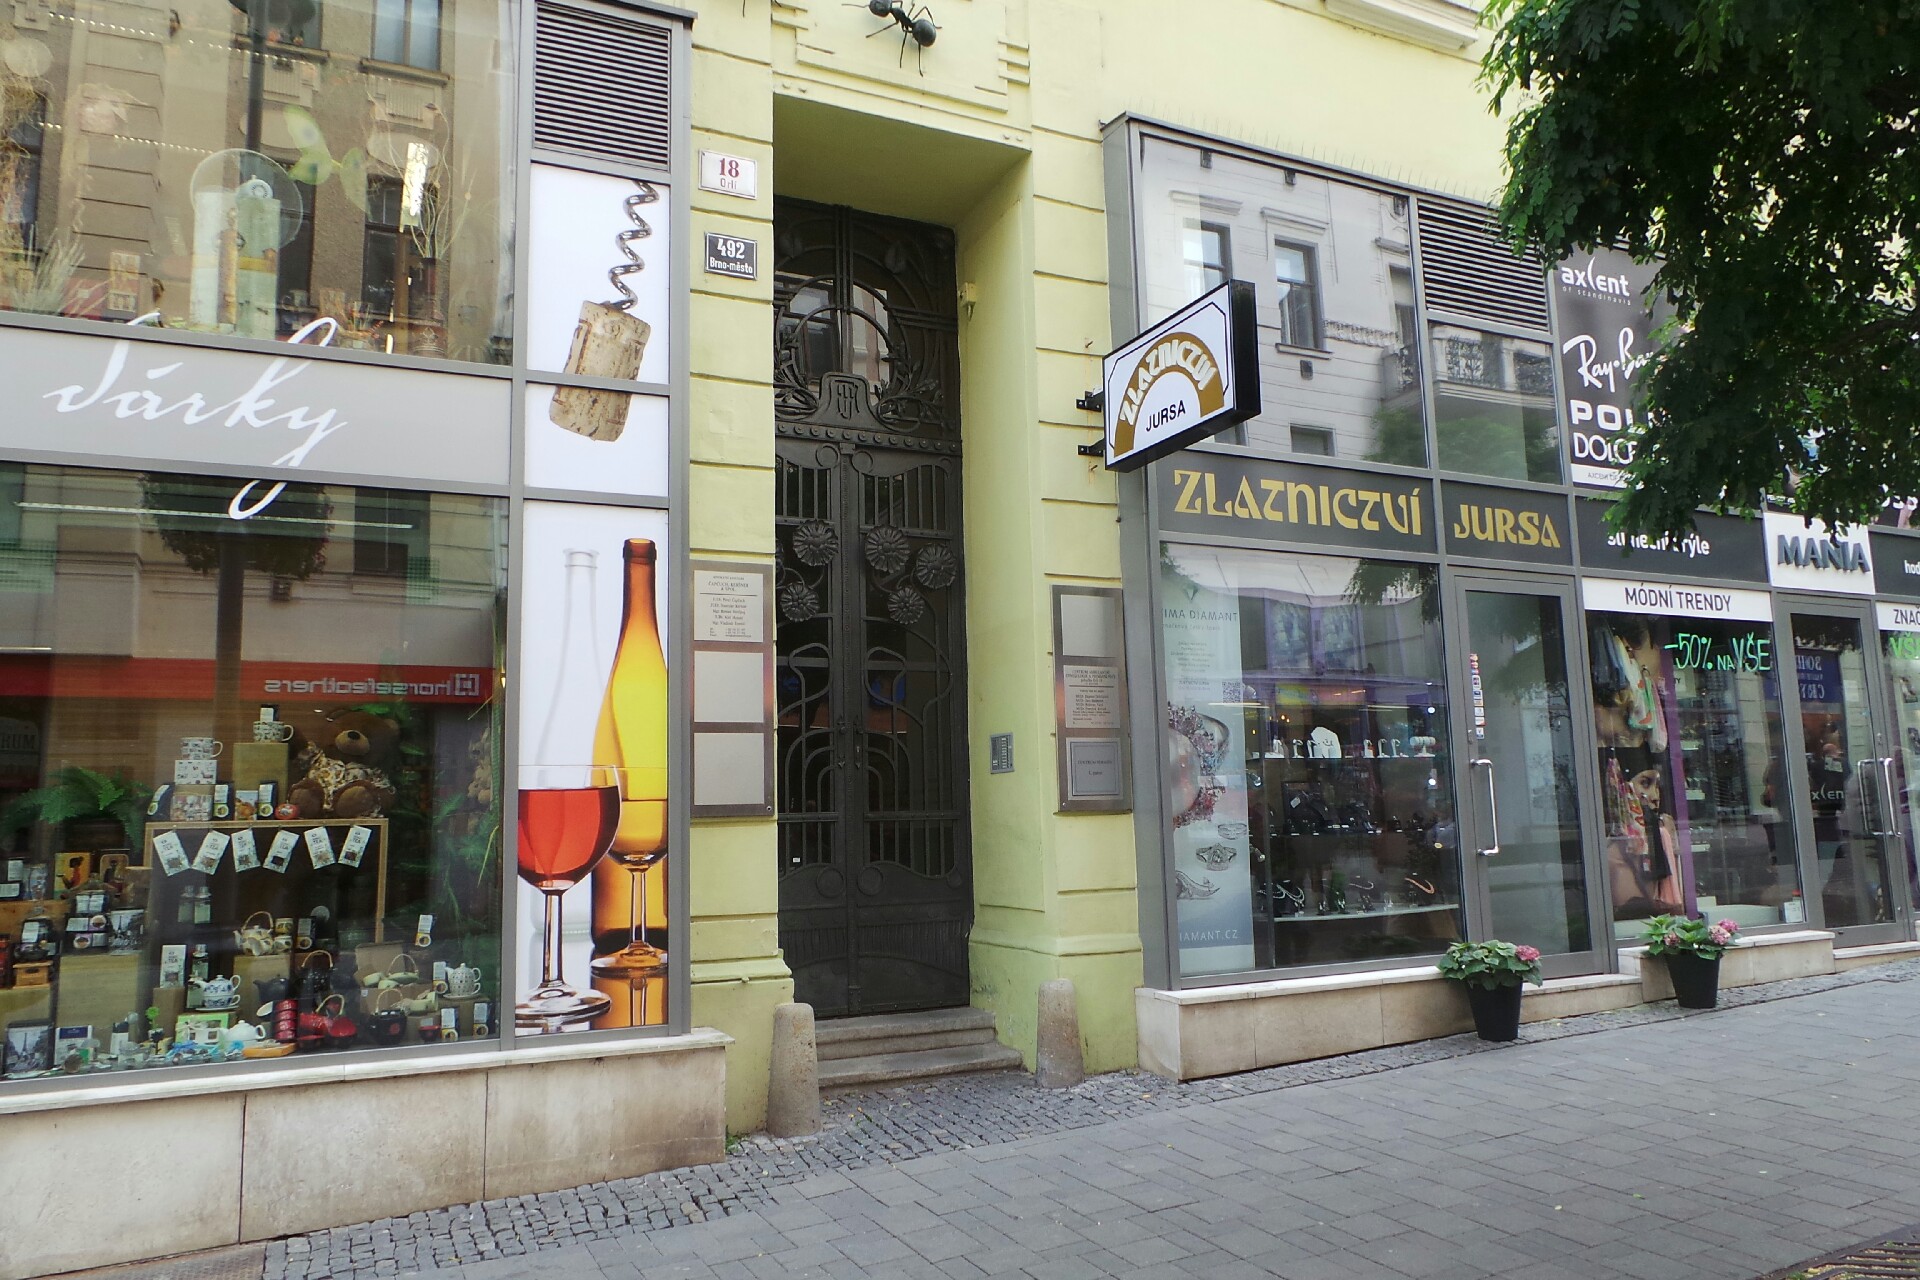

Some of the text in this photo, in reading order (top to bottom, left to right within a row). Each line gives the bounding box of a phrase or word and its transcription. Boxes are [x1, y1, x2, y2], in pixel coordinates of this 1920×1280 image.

[719, 158, 740, 178] 18
[717, 238, 745, 259] 492
[710, 257, 753, 273] Brno-město
[1145, 400, 1187, 432] JURSA
[1454, 504, 1561, 549] JURSA
[1777, 534, 1871, 574] MANIA
[1625, 583, 1731, 613] MÓDNÍ TRENDY
[1189, 609, 1238, 622] DIAMANT
[1664, 631, 1771, 673] -50% NA VŠE
